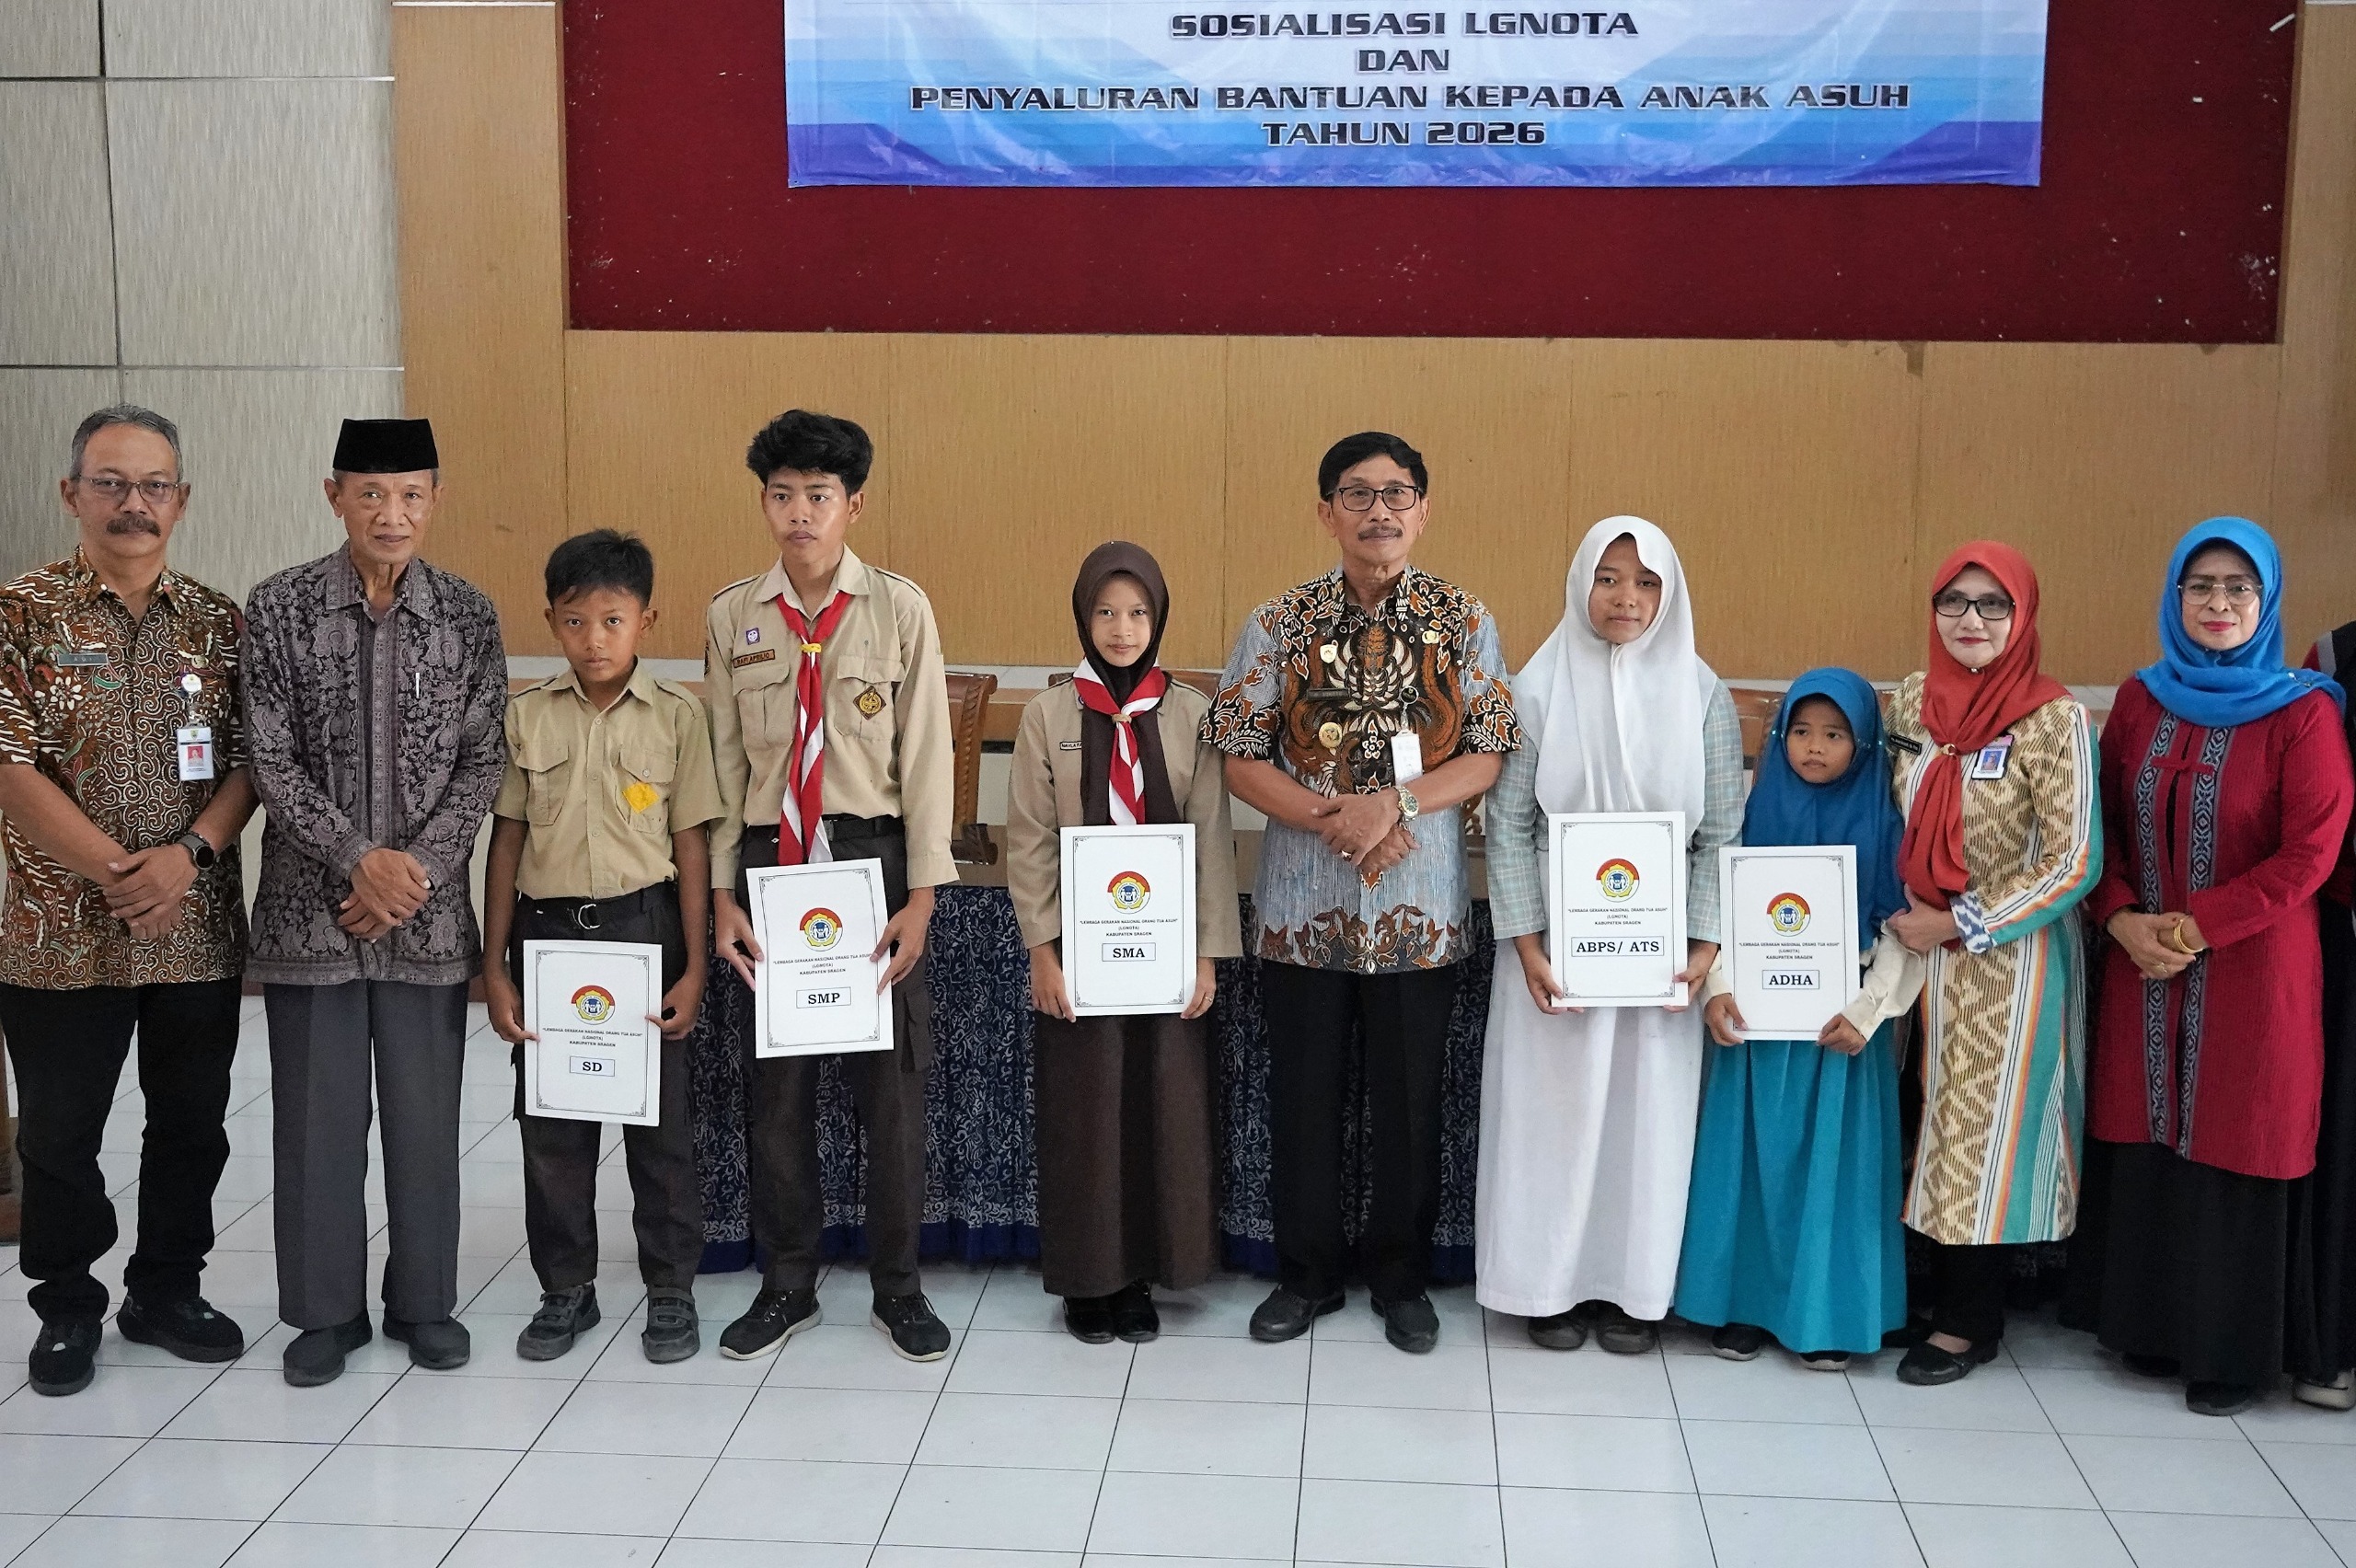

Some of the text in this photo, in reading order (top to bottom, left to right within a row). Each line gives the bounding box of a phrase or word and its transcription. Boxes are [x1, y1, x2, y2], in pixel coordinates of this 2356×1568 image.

[1172, 12, 1639, 38] SOSIALISASI LGNOTA
[1357, 49, 1450, 73] DAN
[911, 85, 1910, 110] PENYALURAN BANTUAN KEPADA ANAK ASUH
[1262, 121, 1546, 146] TAHUN 2026
[1113, 948, 1146, 959] SMA
[1576, 940, 1659, 954] ABPS/ ATS
[1768, 974, 1813, 986] ADHA
[808, 992, 840, 1005] SMP
[582, 1061, 603, 1072] SD
